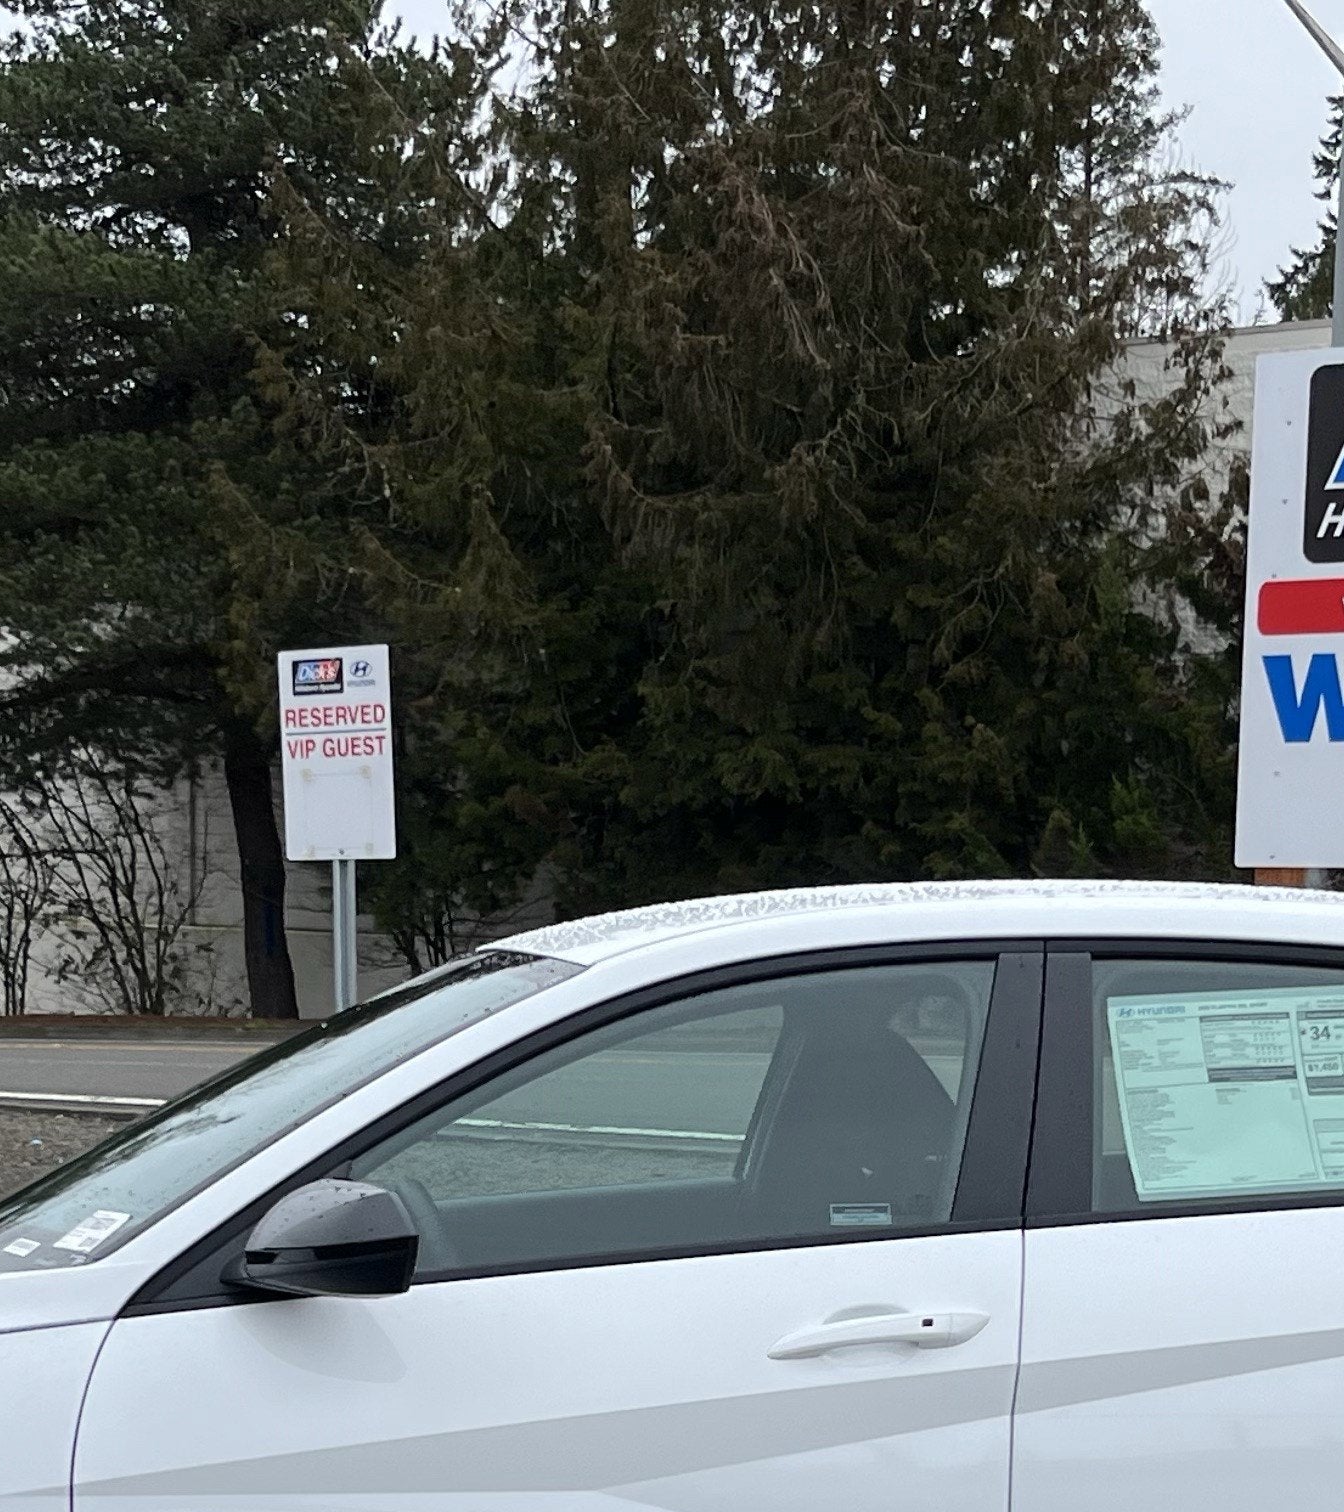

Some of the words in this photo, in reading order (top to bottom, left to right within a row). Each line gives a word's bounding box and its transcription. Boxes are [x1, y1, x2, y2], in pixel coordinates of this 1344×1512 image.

[285, 703, 386, 729] RESERVED
[287, 739, 316, 759] VIP
[322, 735, 386, 758] GUEST
[1310, 1025, 1331, 1040] 34
